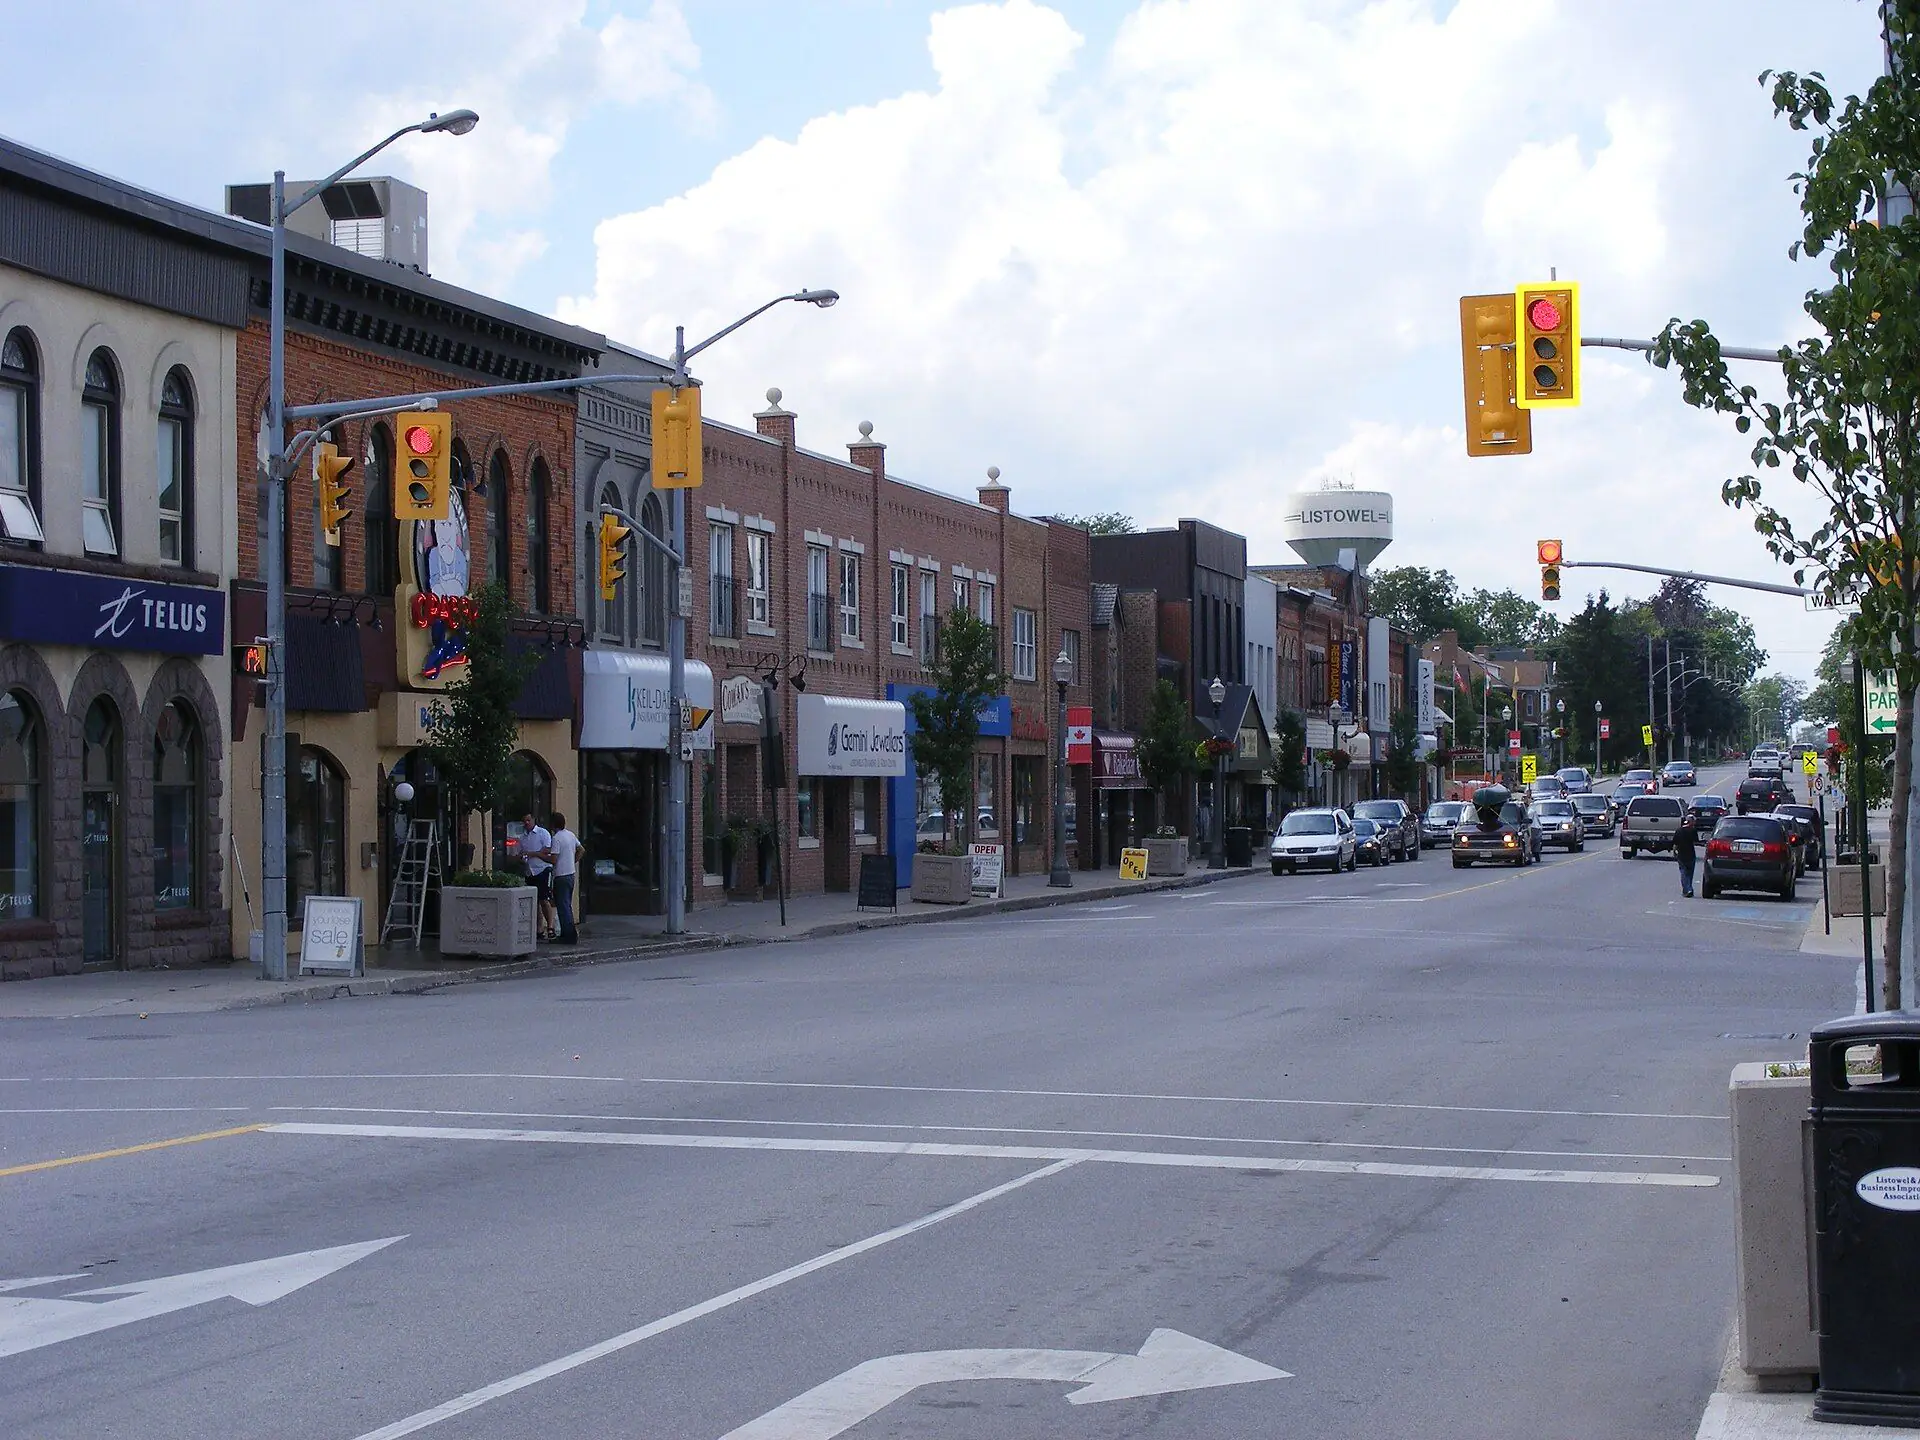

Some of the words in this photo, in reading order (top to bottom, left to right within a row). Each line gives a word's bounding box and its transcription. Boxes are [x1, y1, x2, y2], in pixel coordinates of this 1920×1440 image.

[1301, 509, 1378, 524] LISTOWEL
[1810, 593, 1860, 608] WALLA
[142, 599, 207, 632] TELUS
[1421, 683, 1430, 722] FASHION
[1869, 692, 1897, 709] PAR
[682, 708, 691, 723] 23
[841, 724, 868, 752] Gemini
[870, 725, 904, 753] Jewellers
[93, 834, 109, 843] TELUS
[974, 845, 997, 855] OPEN
[1123, 857, 1144, 878] OPEN
[172, 886, 190, 897] TELUS
[9, 895, 33, 906] TELUS
[311, 926, 348, 945] sale
[1876, 1176, 1910, 1184] Listowel
[1883, 1192, 1919, 1200] Associati
